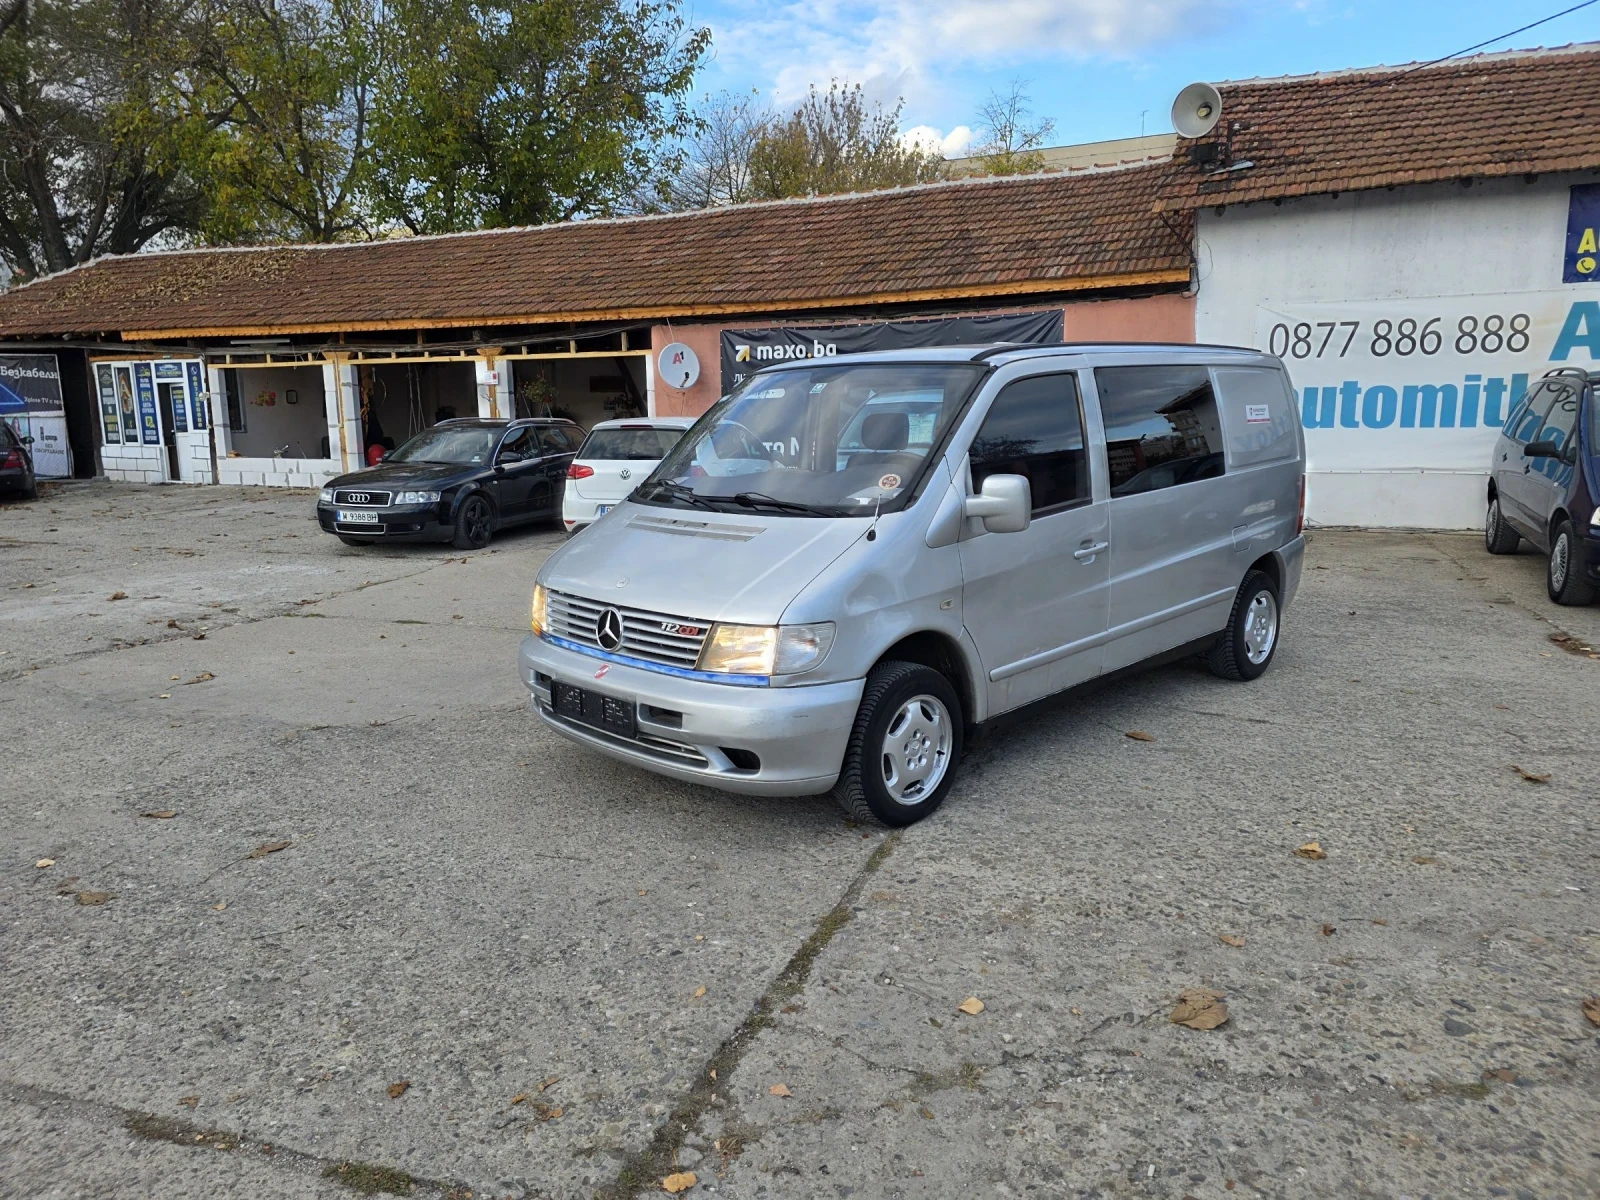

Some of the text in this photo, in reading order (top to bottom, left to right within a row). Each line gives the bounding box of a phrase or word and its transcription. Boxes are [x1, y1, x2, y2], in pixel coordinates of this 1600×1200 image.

[1577, 227, 1600, 254] A
[1268, 313, 1531, 359] 0877 886 888
[672, 350, 685, 365] A1
[0, 365, 61, 379] Безкабелн
[1293, 373, 1529, 429] utomit
